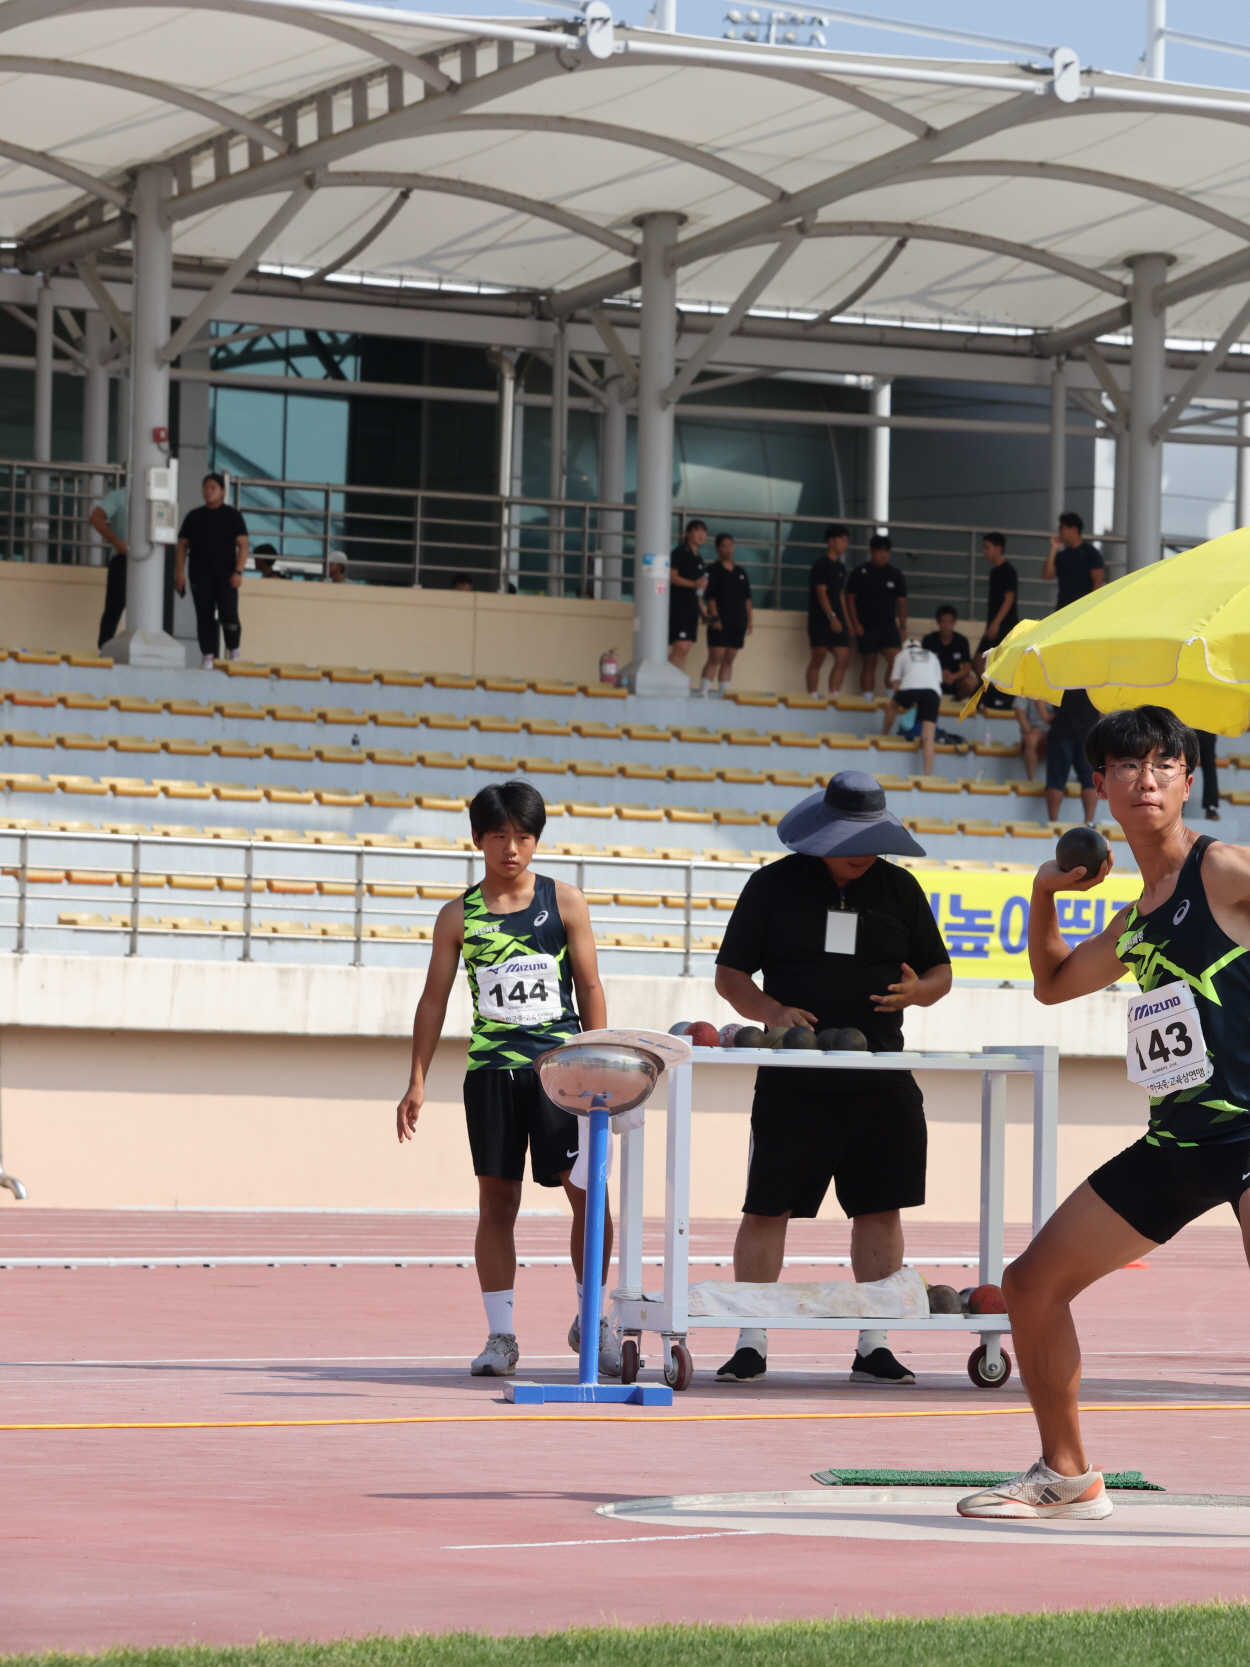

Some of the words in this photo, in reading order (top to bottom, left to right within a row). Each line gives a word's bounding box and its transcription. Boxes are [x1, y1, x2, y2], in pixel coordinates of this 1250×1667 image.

[505, 962, 548, 974] MIZUNO
[488, 978, 549, 1008] 144
[1133, 995, 1181, 1021] MIZUNO
